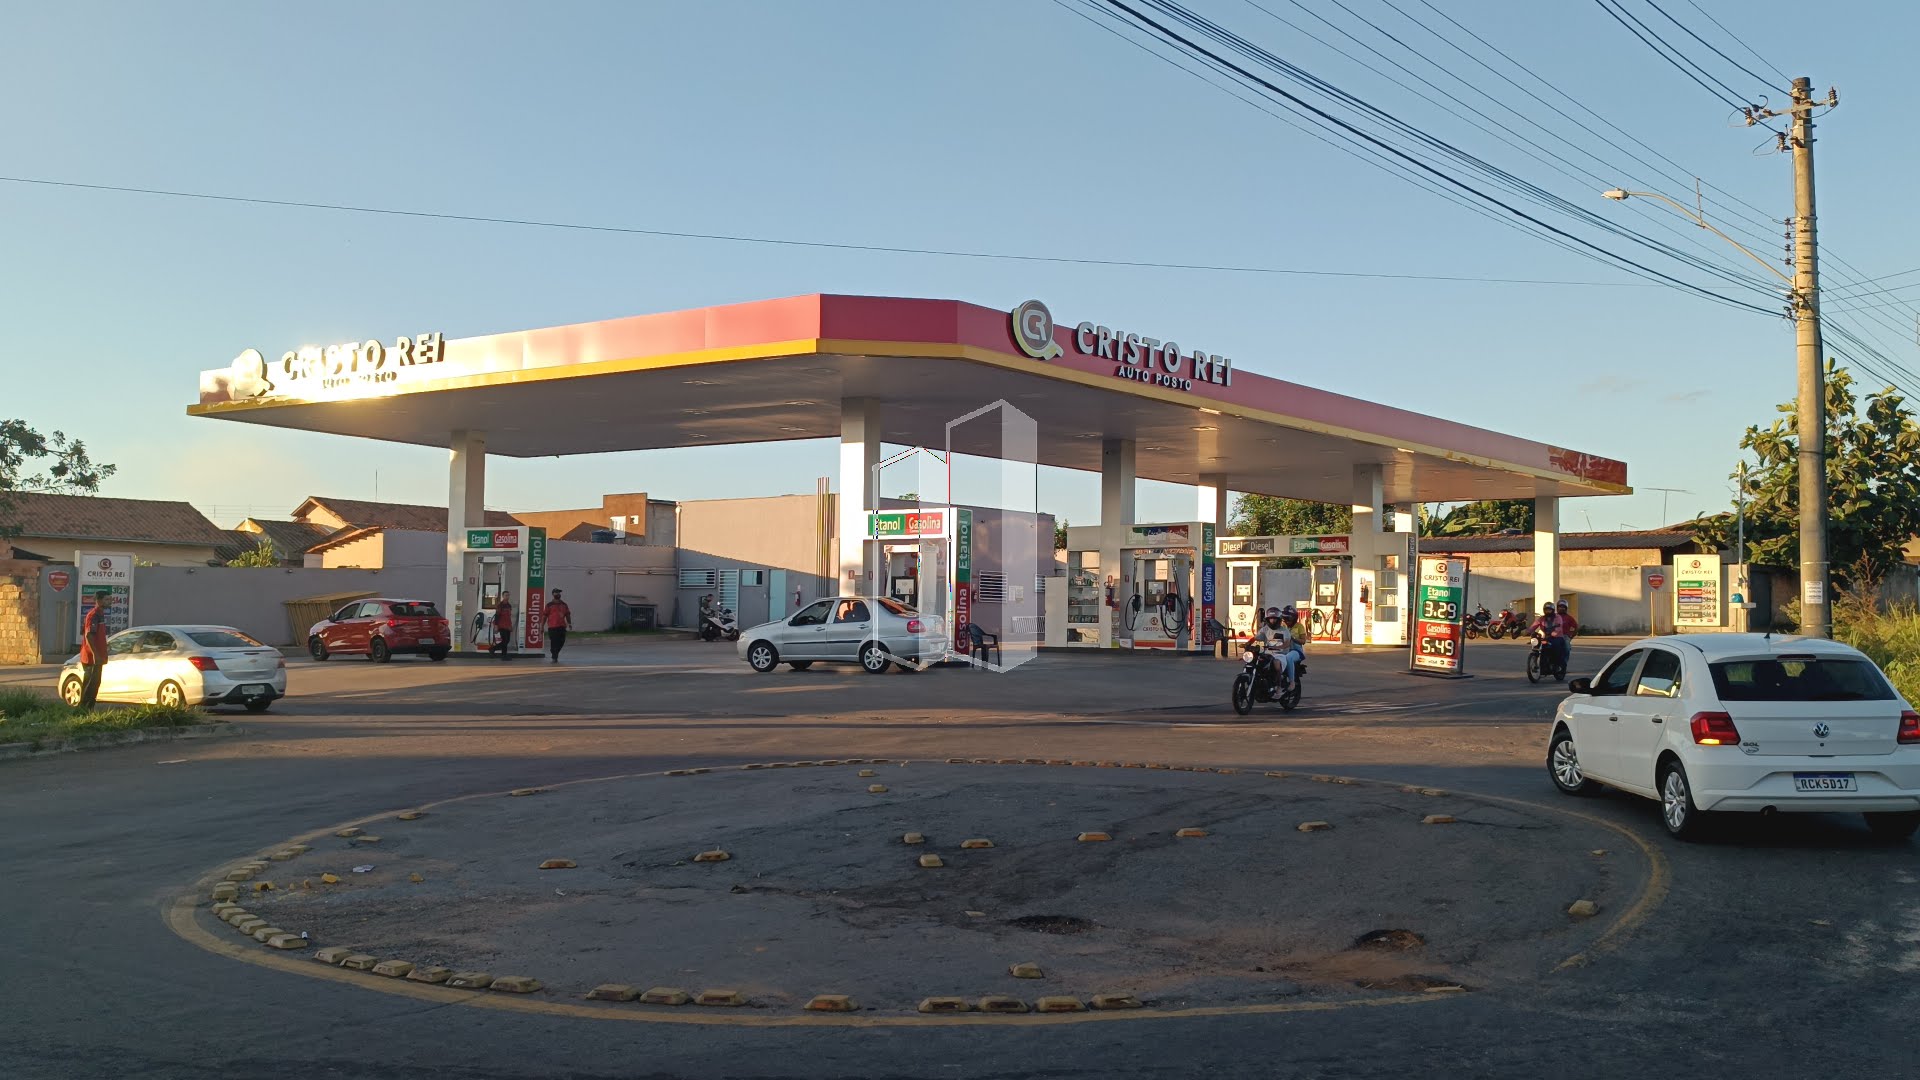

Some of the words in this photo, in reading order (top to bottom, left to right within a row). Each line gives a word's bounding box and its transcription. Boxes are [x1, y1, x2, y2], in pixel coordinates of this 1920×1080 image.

[281, 339, 386, 380] CRISTO
[396, 331, 445, 366] REI
[1077, 321, 1182, 373] CRISTO
[1193, 350, 1232, 387] REI
[1118, 366, 1149, 382] AUTO
[1156, 375, 1192, 391] POSTO
[875, 517, 901, 531] Etanol
[908, 516, 941, 531] Gasolina
[471, 533, 490, 544] Etanol
[494, 532, 517, 544] Gasolina
[958, 520, 968, 569] Etanol
[1204, 528, 1213, 557] Etanol
[1222, 541, 1243, 551] Diesel
[1250, 541, 1271, 551] Diesel
[1293, 540, 1315, 550] Etanol
[1320, 539, 1346, 550] Gasolina
[530, 536, 542, 578] Etanol
[87, 570, 113, 578] CRISTO
[1424, 574, 1448, 582] CRISTO
[1204, 567, 1213, 602] Gasolina
[1427, 587, 1451, 598] Etanol
[528, 593, 541, 644] Gasolina
[957, 588, 967, 649] Gasolina
[1424, 601, 1457, 619] 3.29
[1426, 623, 1452, 634] Gasolina
[1421, 637, 1454, 656] 5.49
[1801, 779, 1849, 789] RCK5D17
